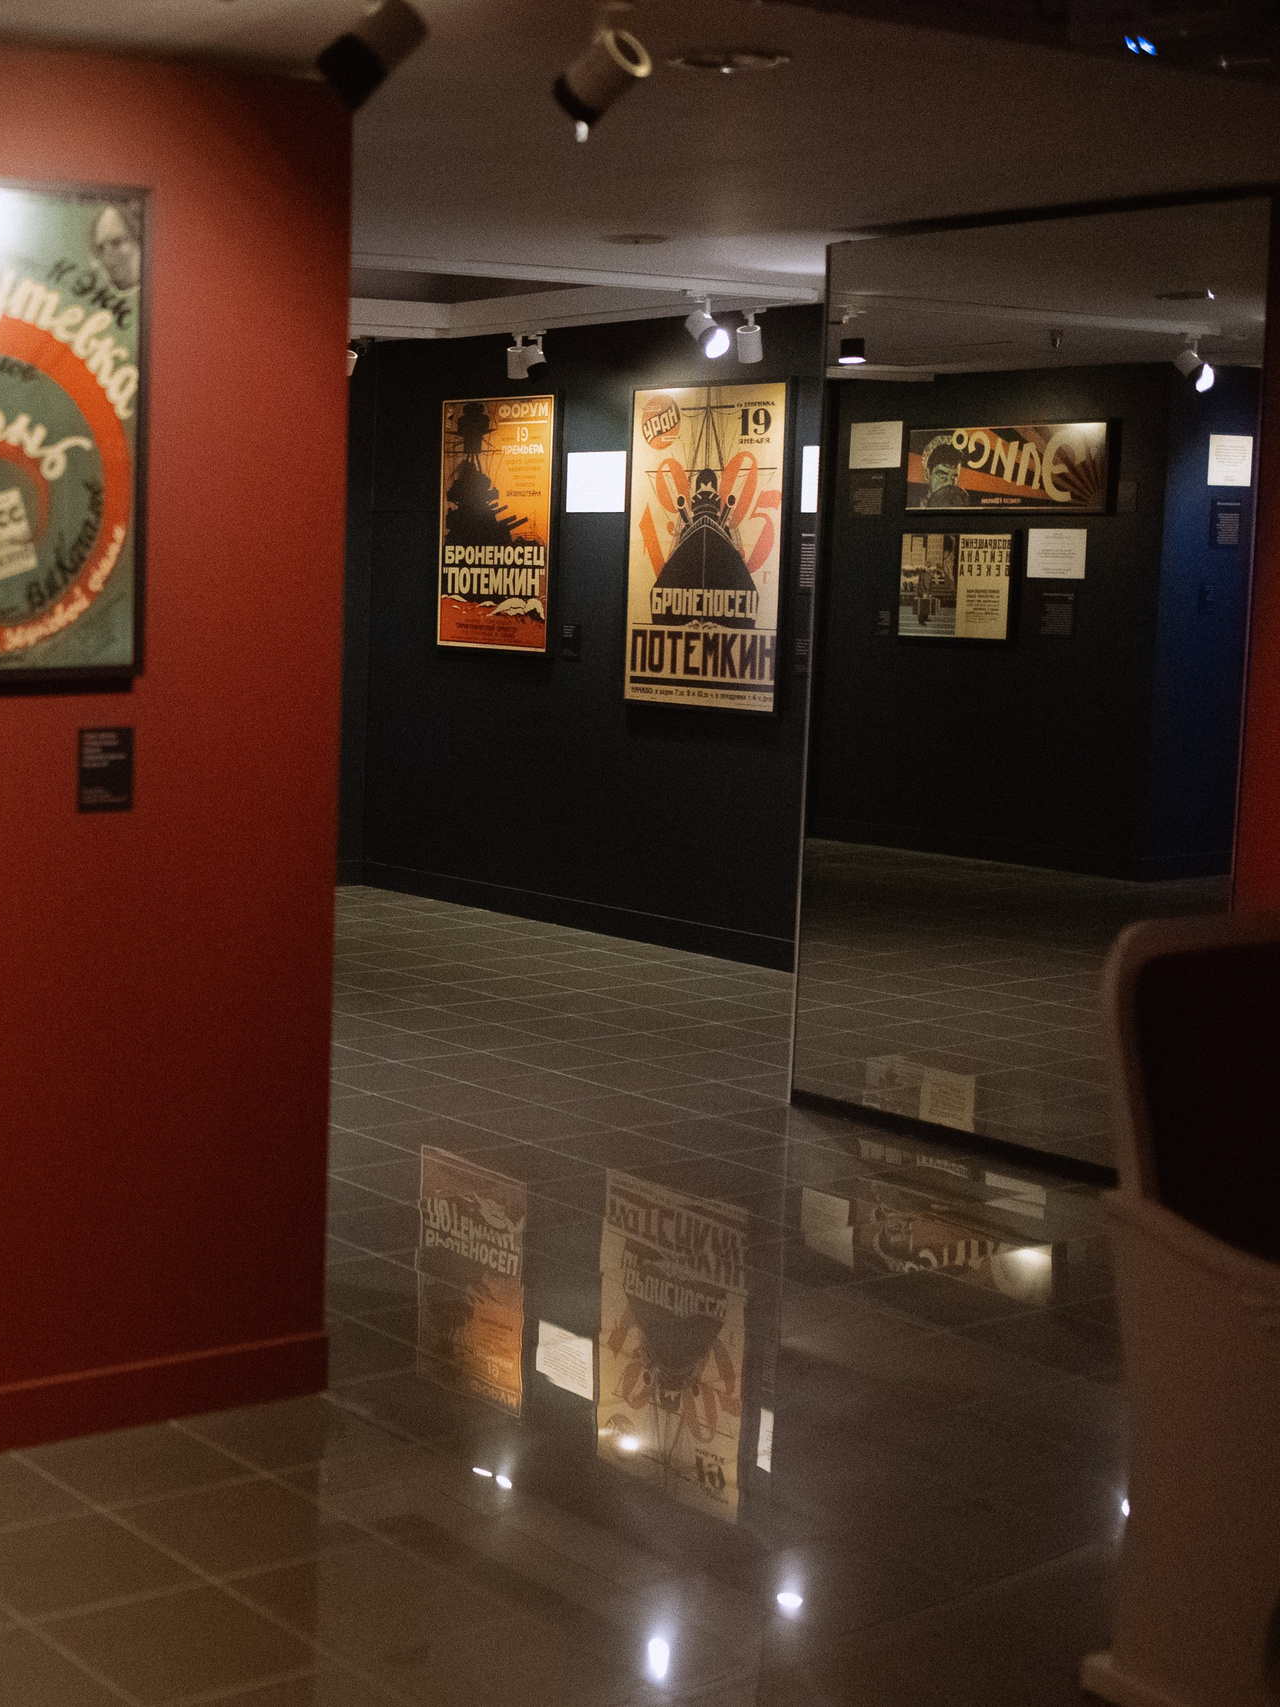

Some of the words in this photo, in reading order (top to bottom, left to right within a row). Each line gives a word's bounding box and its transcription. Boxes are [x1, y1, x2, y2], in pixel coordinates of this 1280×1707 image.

[498, 402, 549, 419] ФОРУМ
[642, 403, 679, 443] УРАН
[738, 407, 772, 436] 19
[516, 426, 529, 442] 19
[501, 444, 544, 455] ПРЕМЬЕРА
[445, 545, 545, 567] БРОНЕНОСЕЦ
[651, 587, 759, 620] БРОНЕНОСЕЦ
[630, 629, 777, 682] ПОТЕМКИН
